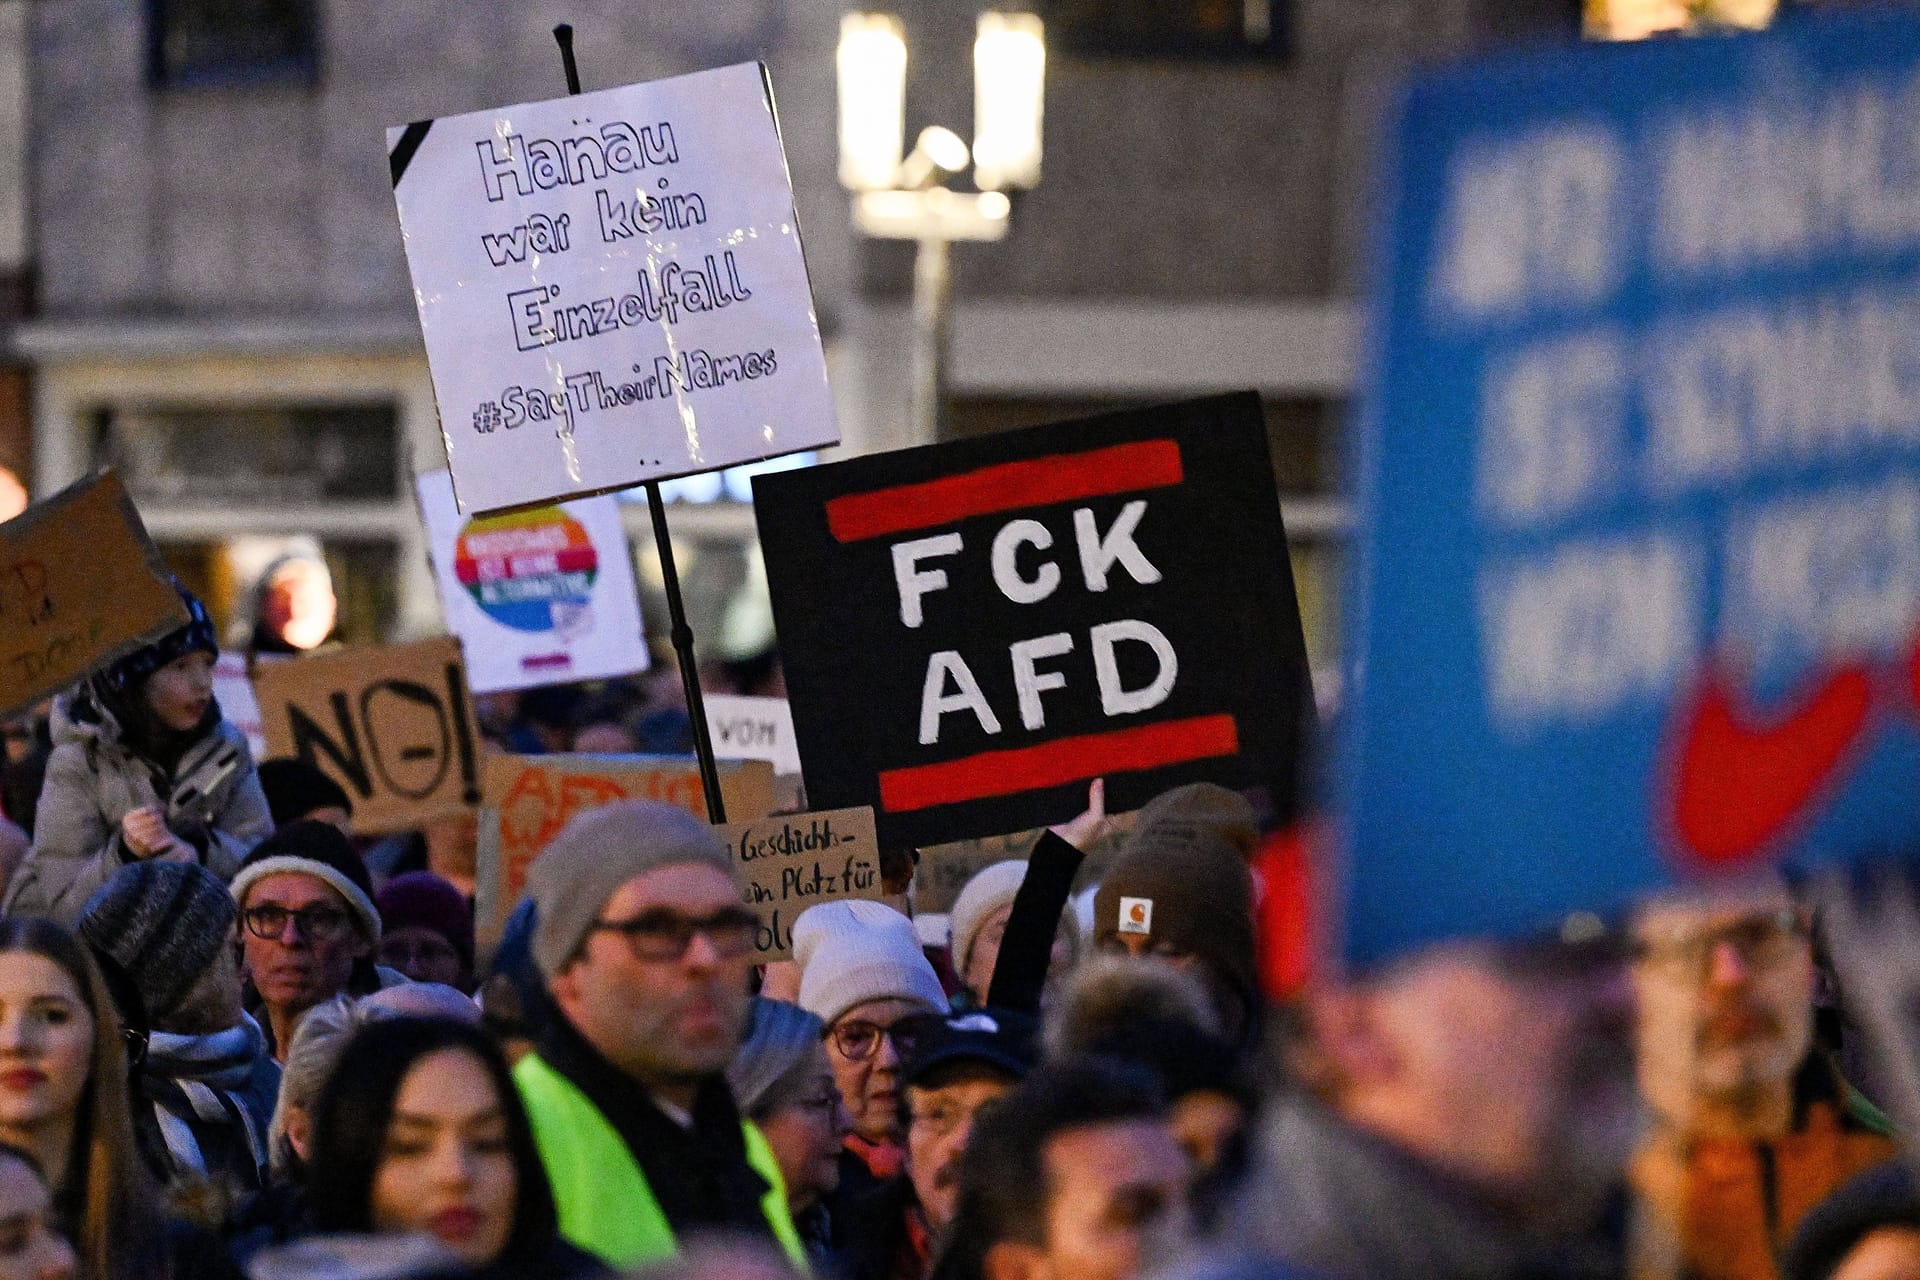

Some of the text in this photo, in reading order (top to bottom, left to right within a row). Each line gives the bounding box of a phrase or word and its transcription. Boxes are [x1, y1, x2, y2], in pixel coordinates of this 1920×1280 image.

[475, 120, 680, 202] Hanau
[481, 178, 708, 267] war kein
[506, 251, 752, 352] Einzelfall
[472, 346, 778, 439] #SayTheirNames
[890, 499, 1163, 628] FCK
[917, 618, 1179, 745] AFD
[286, 661, 482, 806] NO!
[741, 855, 877, 904] ein Platz für
